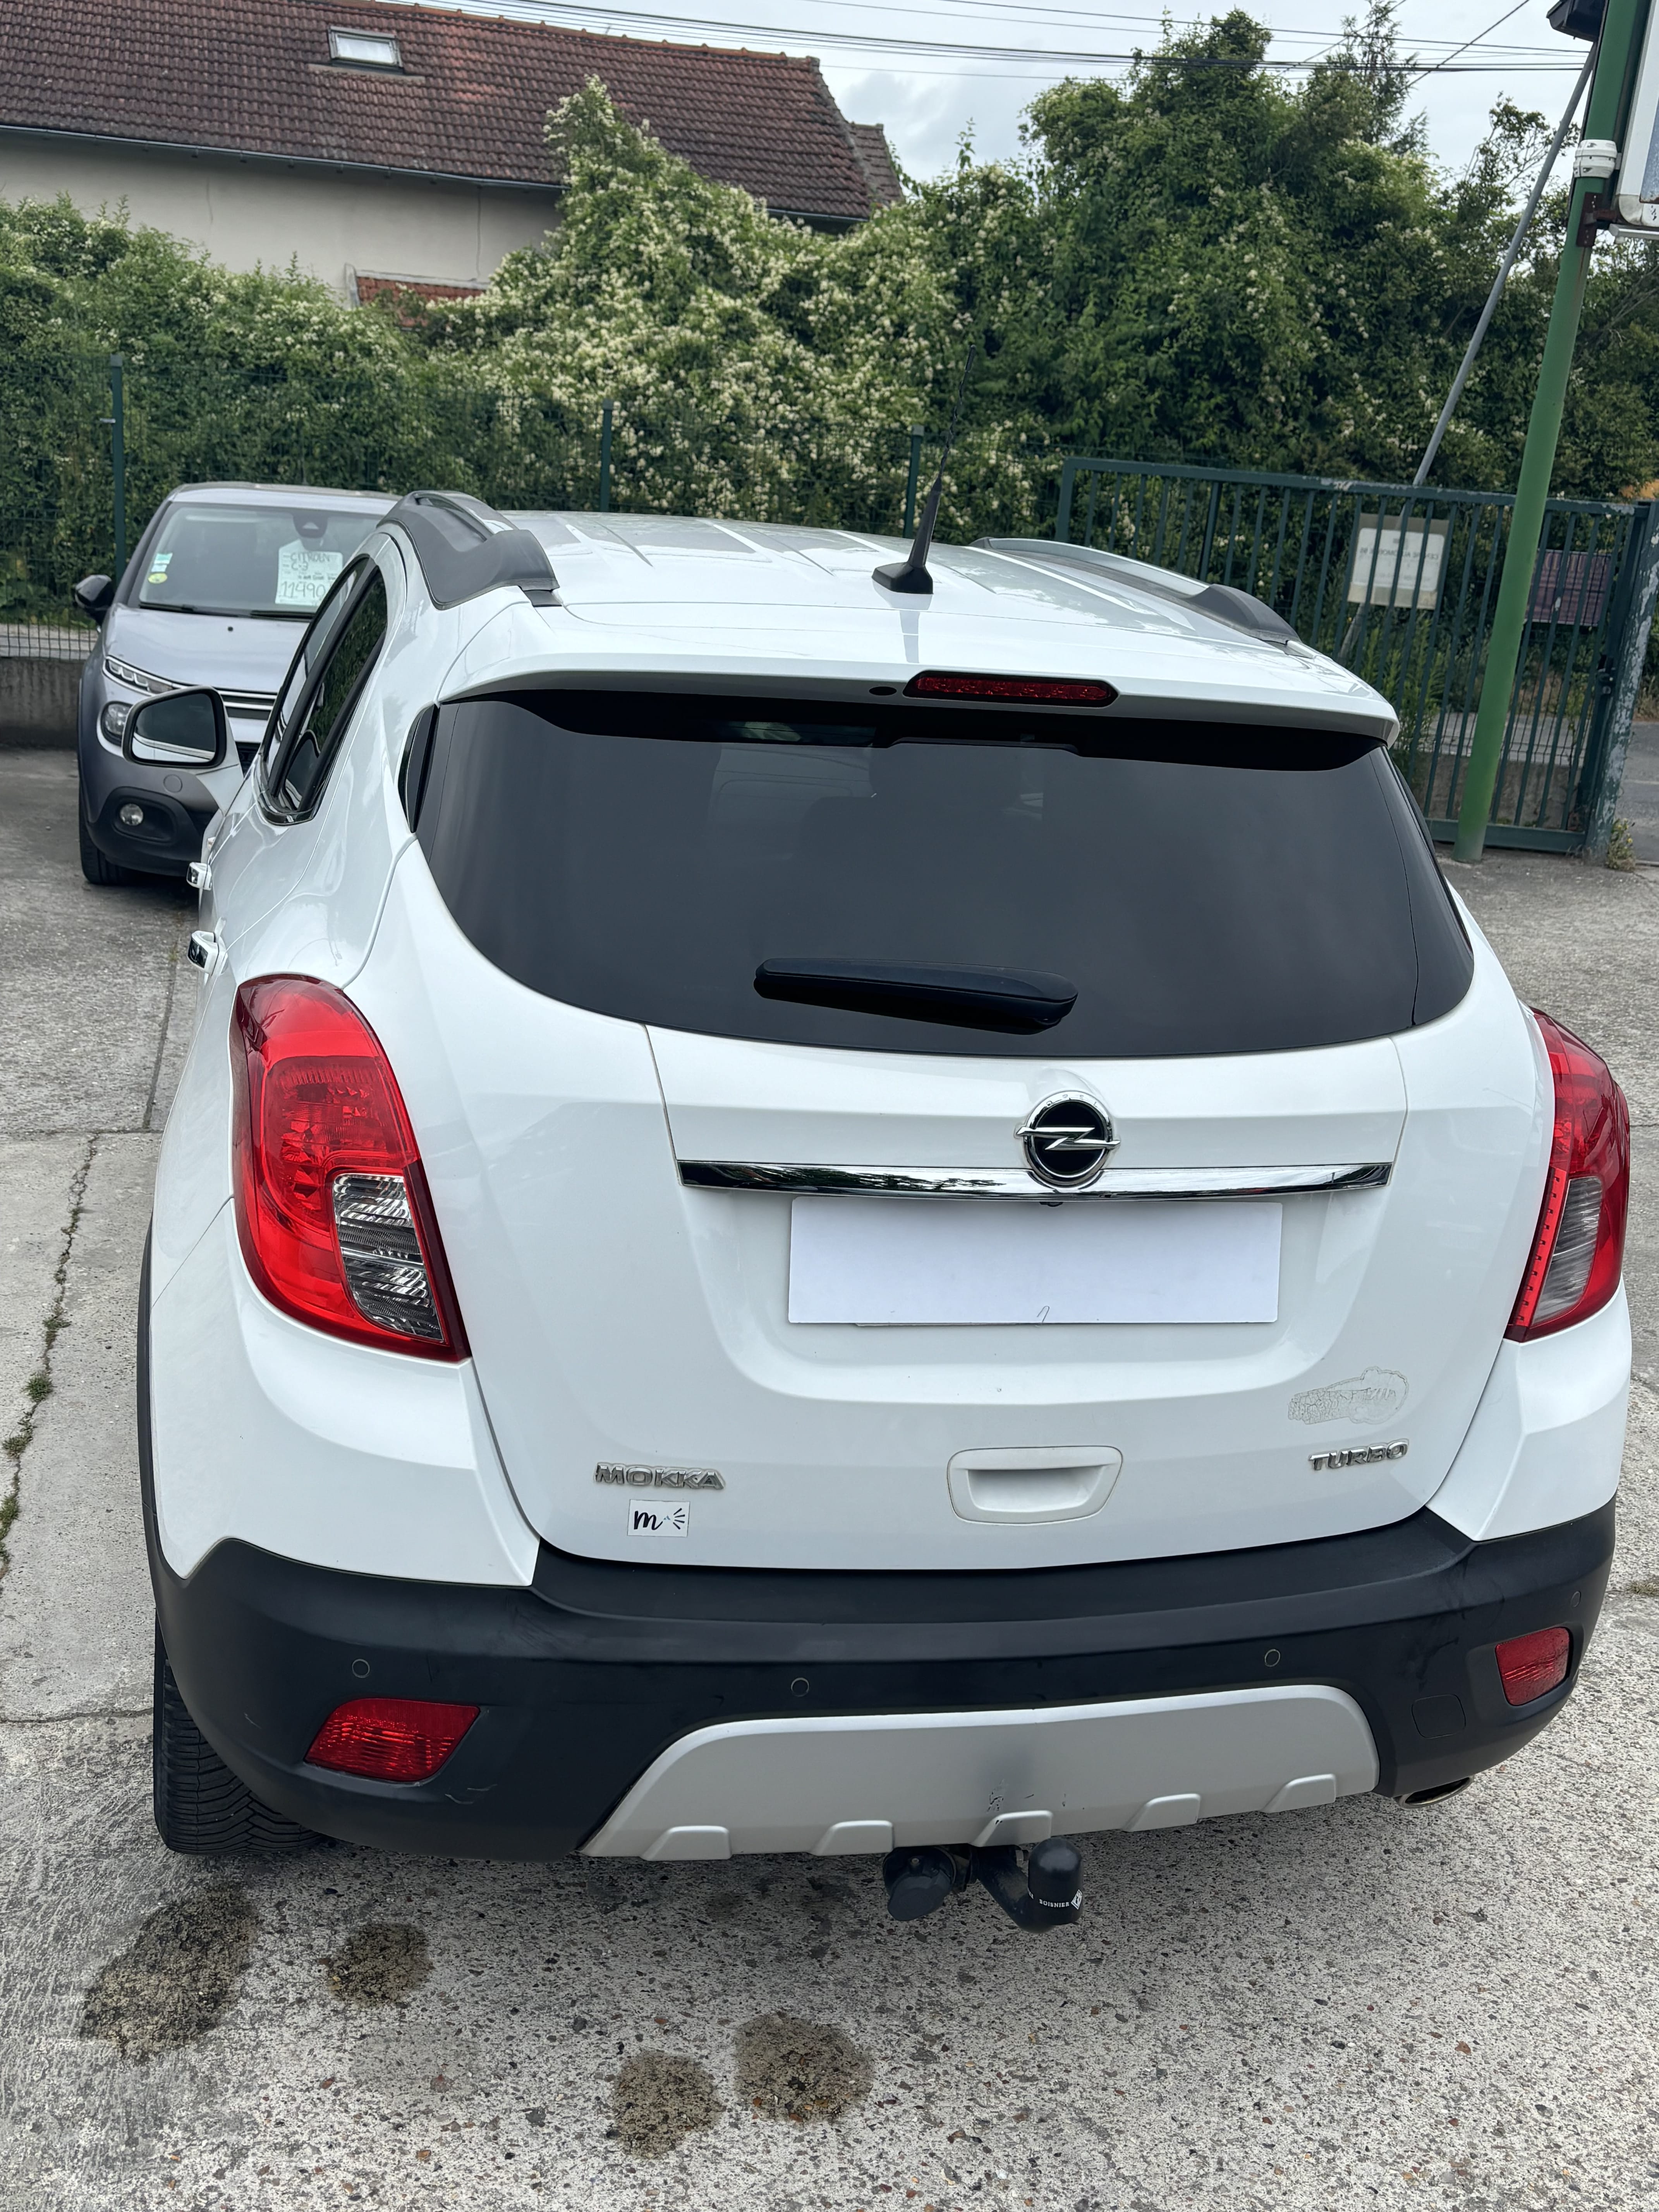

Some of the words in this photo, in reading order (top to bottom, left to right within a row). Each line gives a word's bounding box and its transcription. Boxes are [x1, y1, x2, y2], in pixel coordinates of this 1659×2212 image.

[1046, 1094, 1098, 1107] OPEL
[1309, 1439, 1408, 1471] TURBO
[594, 1463, 725, 1490] MOKKA
